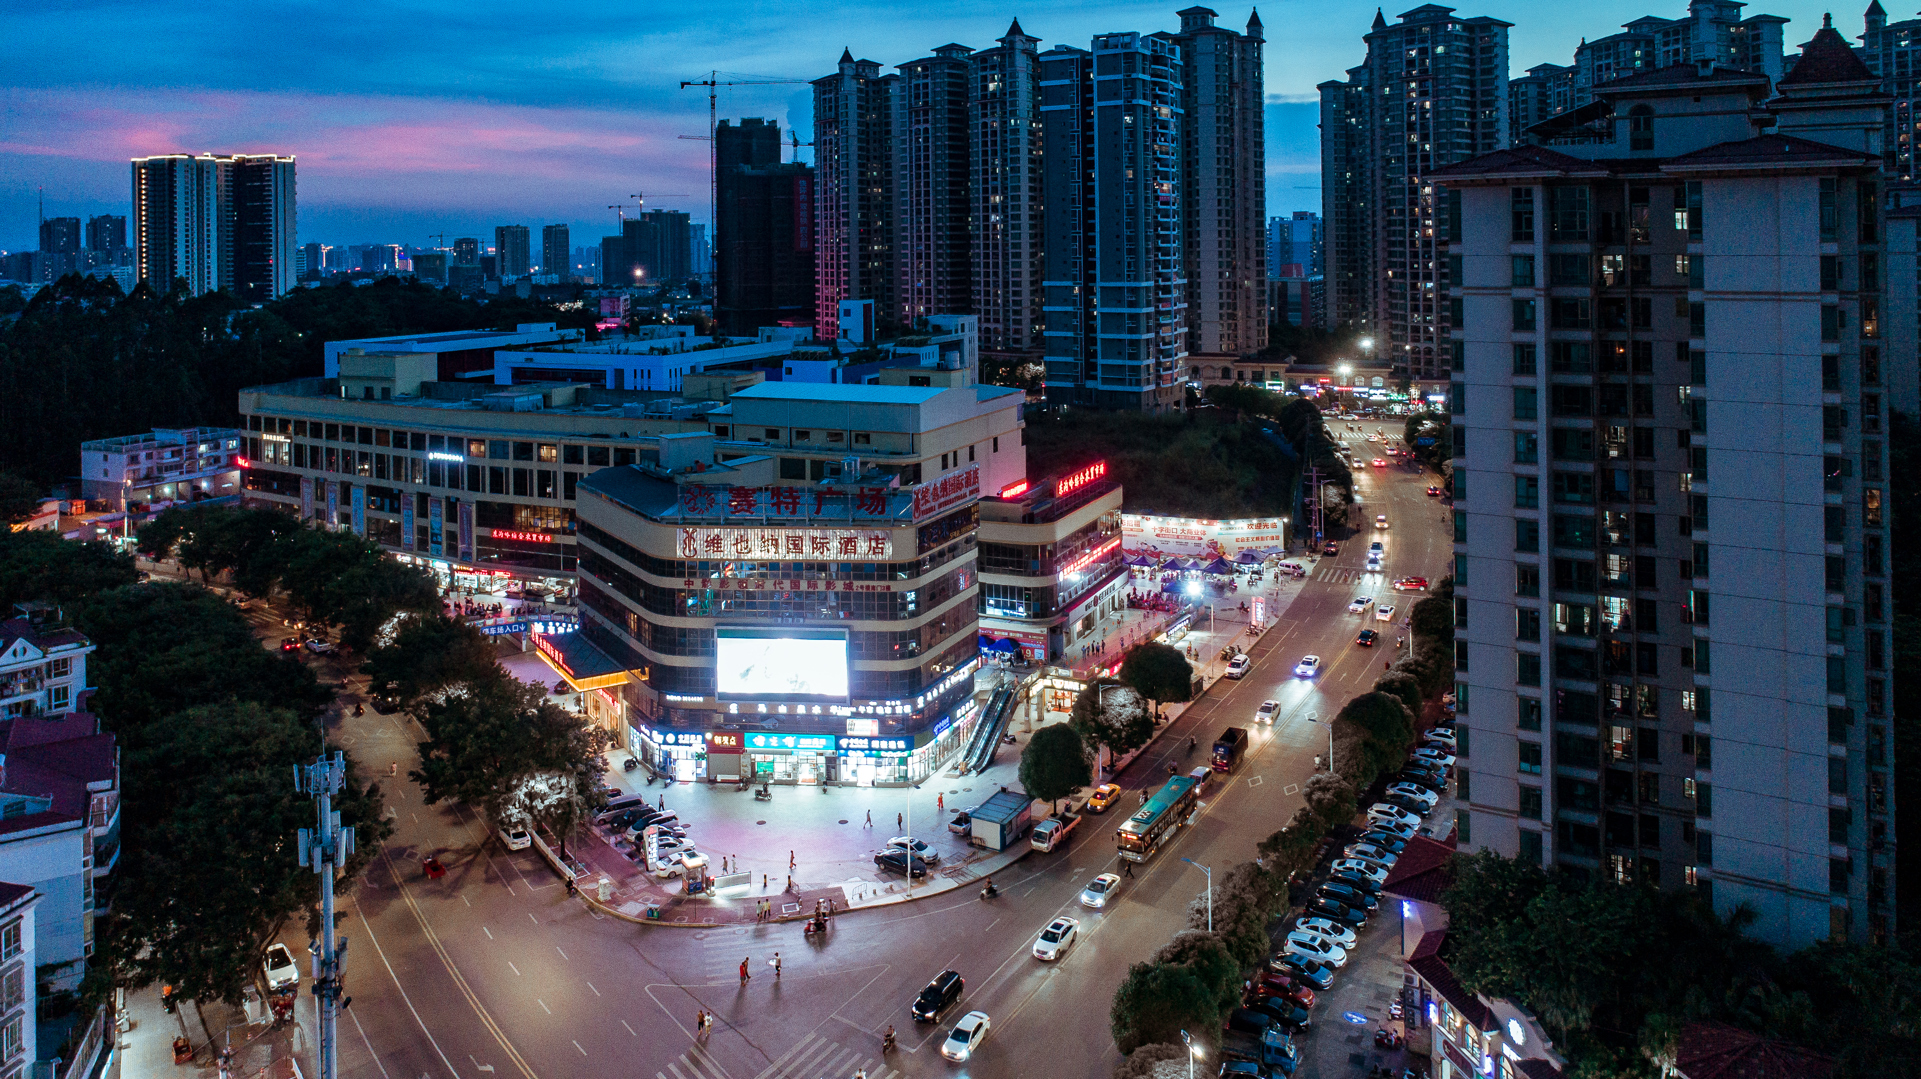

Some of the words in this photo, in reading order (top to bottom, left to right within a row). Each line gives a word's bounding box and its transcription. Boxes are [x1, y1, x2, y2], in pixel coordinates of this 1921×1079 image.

[728, 486, 887, 516] 赛特广场
[1247, 522, 1277, 530] 欢迎光临
[704, 534, 886, 556] 维也纳国际酒店
[482, 624, 519, 635] 停车场入口
